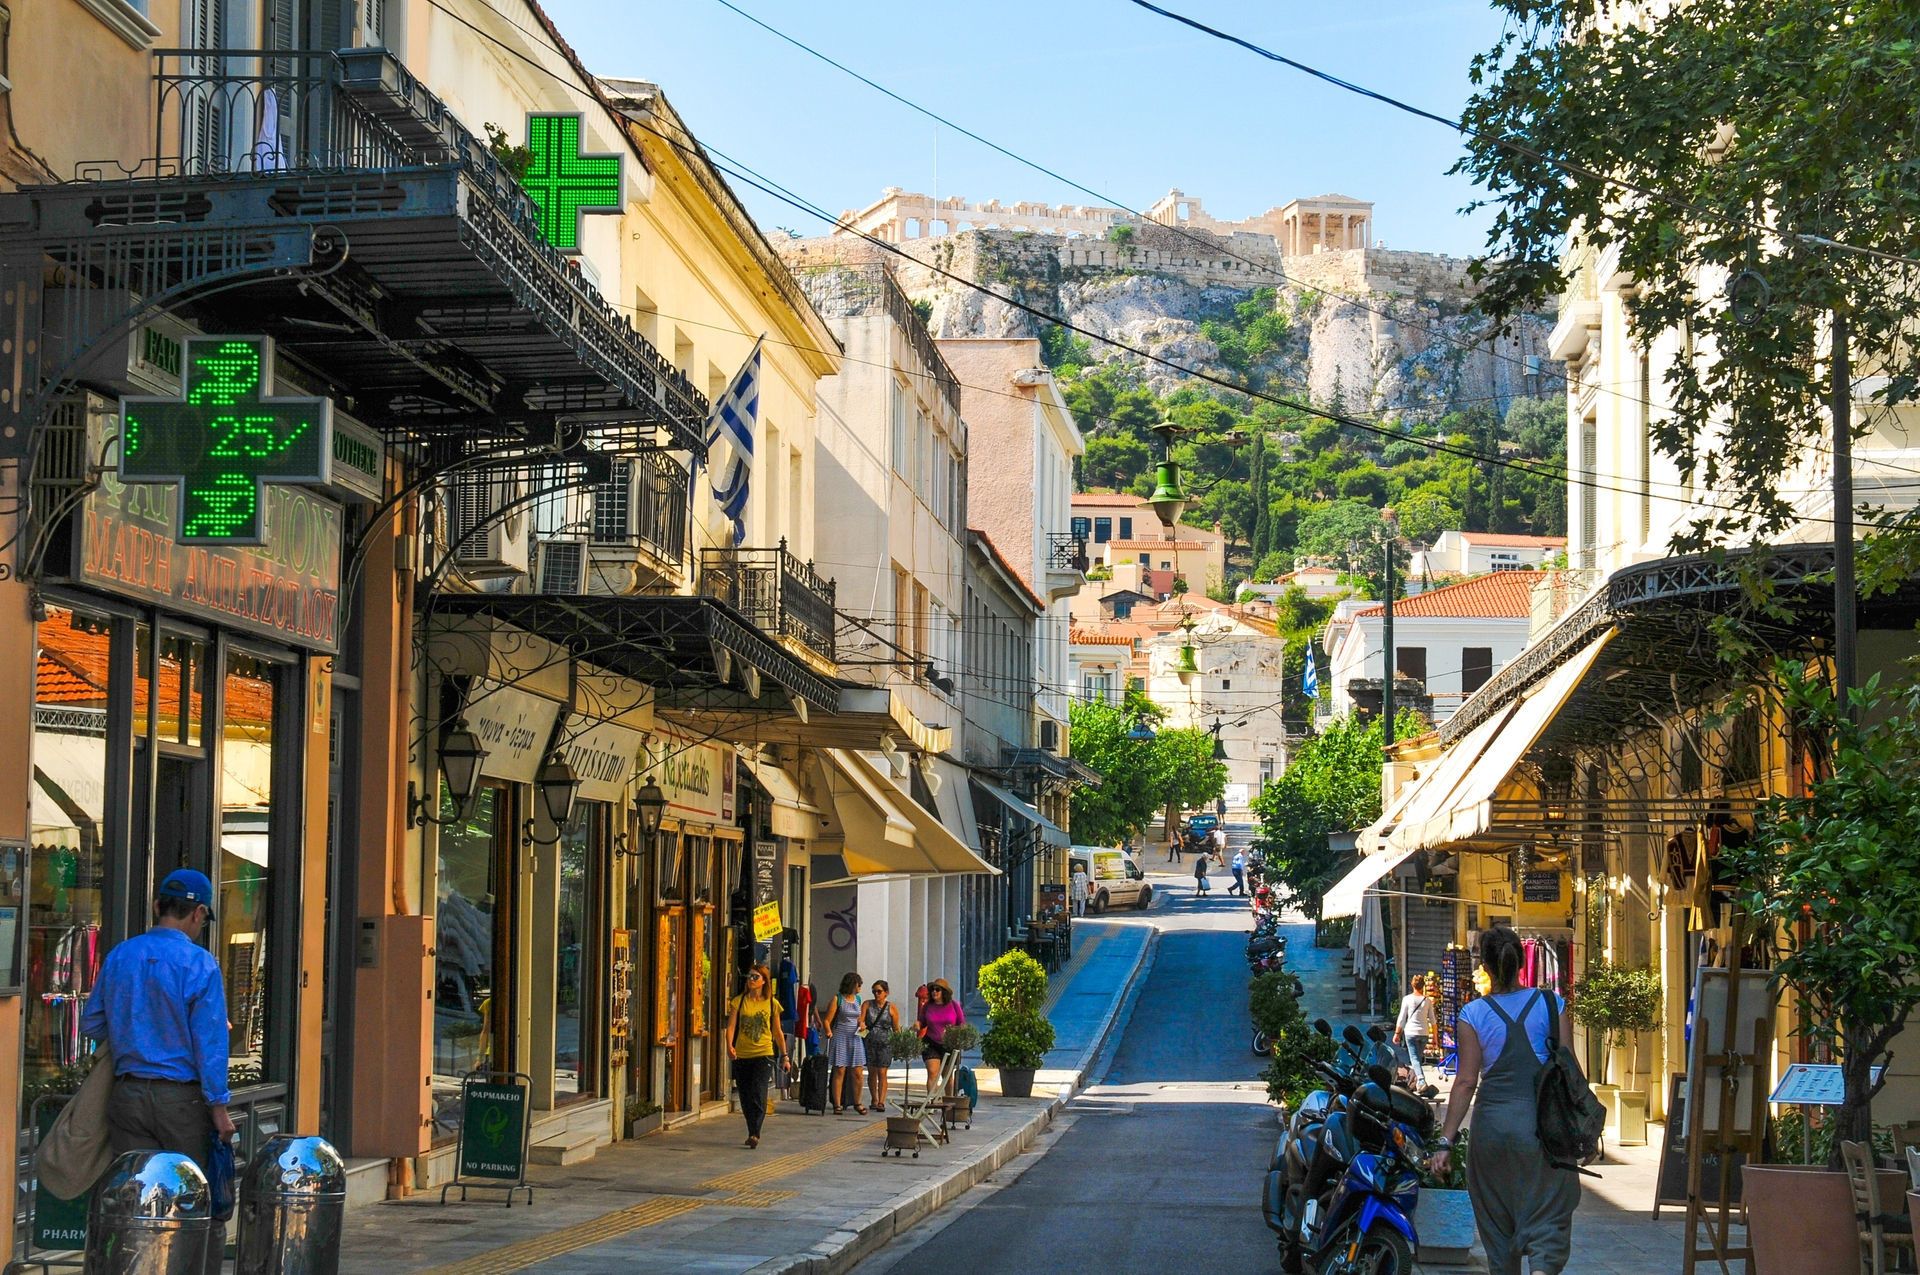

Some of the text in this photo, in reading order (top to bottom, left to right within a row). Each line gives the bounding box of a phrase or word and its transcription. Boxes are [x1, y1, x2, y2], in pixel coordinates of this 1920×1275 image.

[143, 326, 181, 377] FAR
[84, 510, 174, 596] ΜΑΙΡΗ
[470, 1090, 520, 1102] ΦΑΡΜΑΚΕΙΟ
[466, 1161, 516, 1172] NO PARKING
